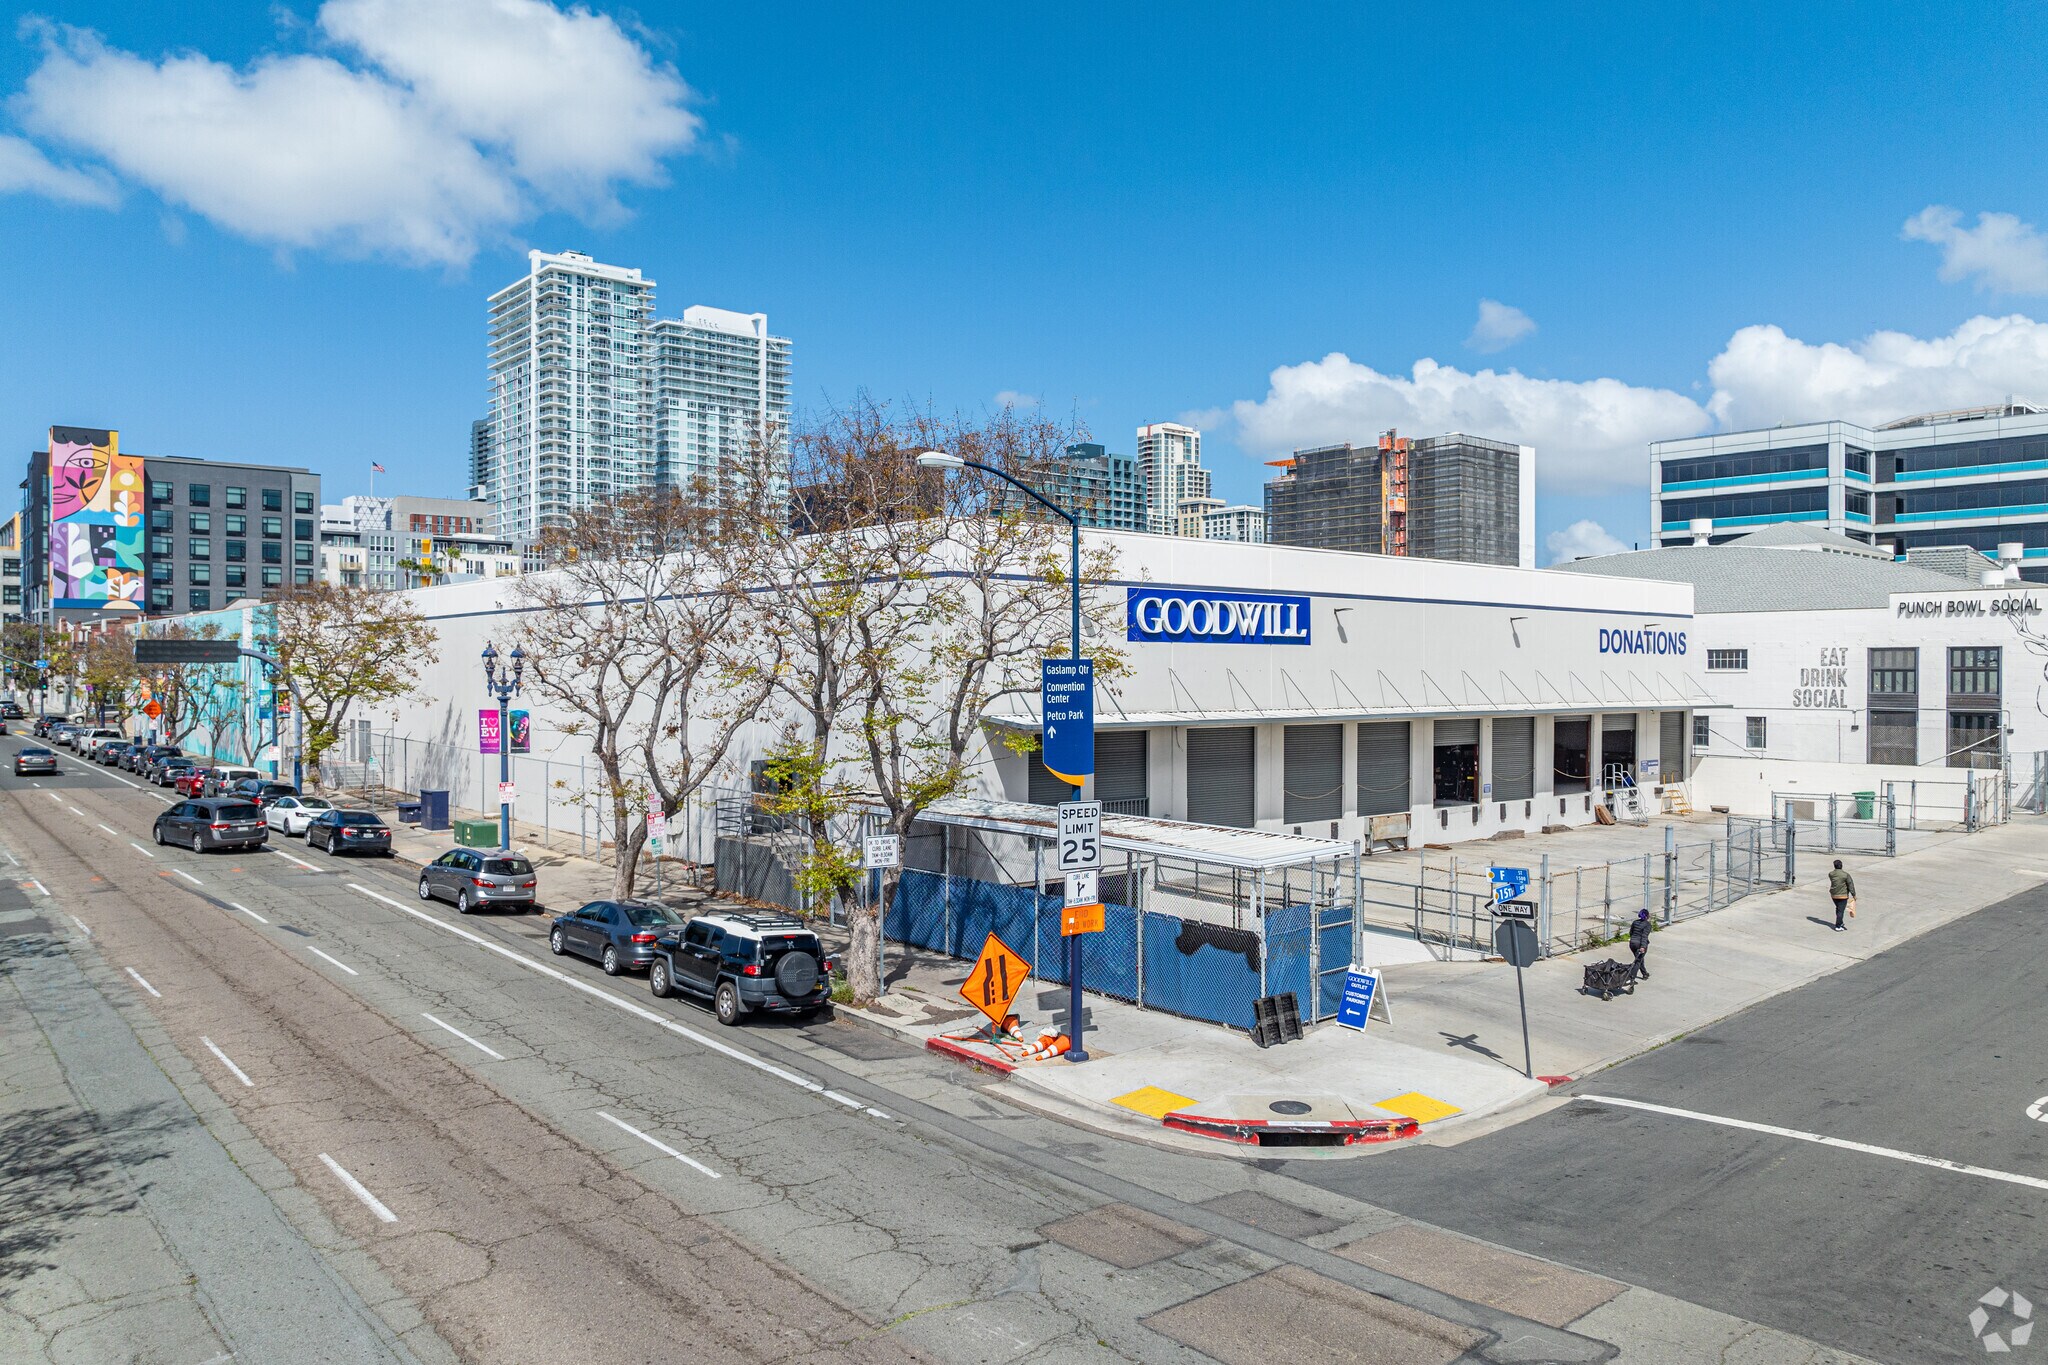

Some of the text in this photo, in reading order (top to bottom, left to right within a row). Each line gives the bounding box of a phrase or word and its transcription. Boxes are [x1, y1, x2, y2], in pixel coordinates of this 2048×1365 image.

[1899, 598, 2042, 614] PUNCH BOWL SOCIAL
[1136, 597, 1307, 637] GOODWILL
[1600, 629, 1686, 655] DONATIONS
[1820, 647, 1848, 666] EAT
[1046, 665, 1089, 676] Gaslamp Qtr
[1800, 668, 1848, 687] DRINK
[1046, 682, 1085, 692] Convention
[1046, 694, 1069, 703] Center
[1792, 689, 1848, 708] SOCIAL
[1047, 710, 1084, 720] Petco Park
[480, 718, 487, 727] I
[480, 728, 498, 737] EV
[1061, 808, 1098, 820] SPEED
[1065, 823, 1093, 835] LIMIT
[1063, 838, 1097, 864] 25
[1500, 870, 1505, 880] F
[1082, 919, 1099, 928] WORK
[1348, 976, 1372, 985] GOODWILL
[1345, 991, 1369, 999] CUSTOMER
[1346, 997, 1365, 1005] PARKING
